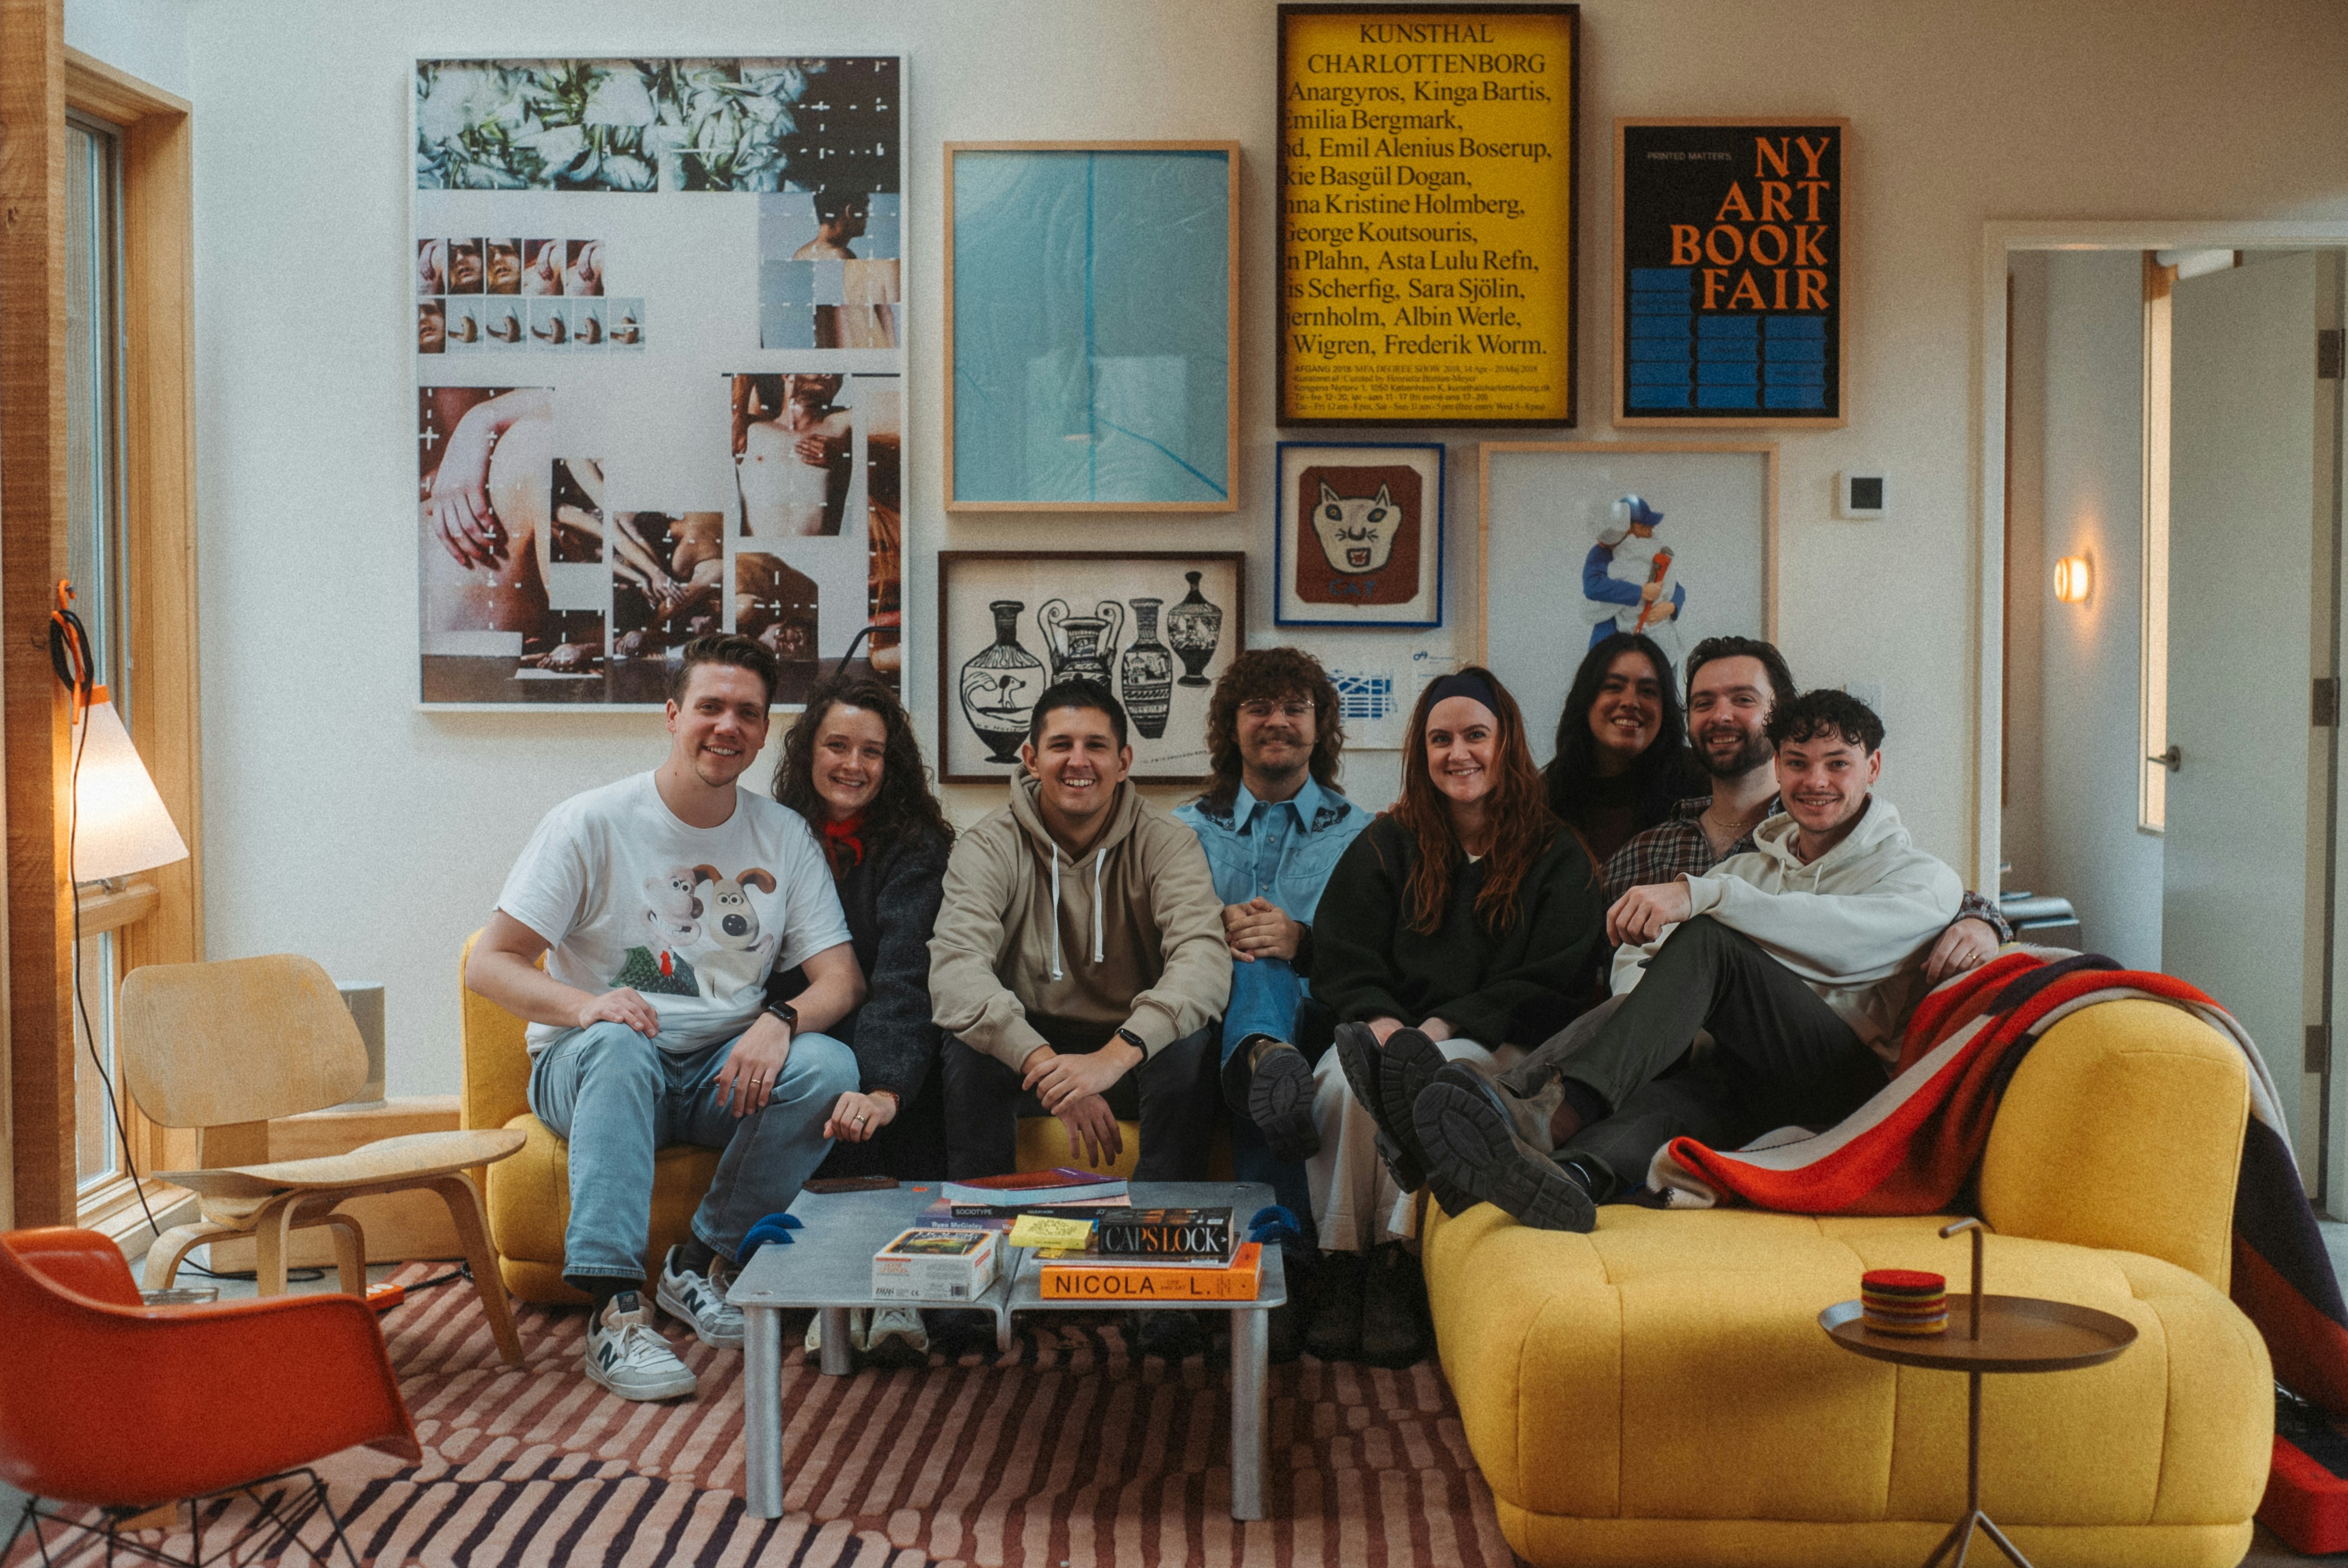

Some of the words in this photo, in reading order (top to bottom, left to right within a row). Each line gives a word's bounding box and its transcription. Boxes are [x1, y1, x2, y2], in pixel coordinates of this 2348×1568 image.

[1360, 22, 1494, 43] KUNSTHAL
[1307, 54, 1545, 73] CHARLOTTENBORG
[1288, 81, 1405, 106] Anargyros,
[1414, 81, 1477, 106] Kinga
[1483, 80, 1551, 103] Bartis,
[1352, 109, 1463, 135] Bergmark,
[1320, 137, 1368, 157] Emil
[1374, 137, 1454, 157] Alenius
[1460, 137, 1552, 163] Boserup,
[1755, 136, 1830, 178] NY
[1320, 166, 1391, 191] Basgül
[1397, 166, 1471, 191] Dogan,
[1326, 194, 1410, 214] Kristine
[1415, 193, 1525, 219] Holmberg,
[1715, 180, 1830, 221] ART
[1358, 221, 1477, 243] Koutsouris,
[1670, 224, 1828, 266] BOOK
[1288, 256, 1300, 270] n
[1305, 250, 1369, 271] Plahn,
[1378, 251, 1425, 270] Asta
[1431, 250, 1478, 270] Lulu
[1484, 250, 1539, 272] Refn,
[1289, 278, 1304, 298] is
[1309, 278, 1400, 303] Scherfig,
[1409, 278, 1454, 298] Sara
[1459, 277, 1525, 303] Sjölin,
[1702, 269, 1829, 310] FAIR
[1394, 306, 1451, 326] Albin
[1457, 306, 1521, 327] Werle,
[1293, 334, 1376, 359] Wigren,
[1386, 334, 1471, 354] Frederik
[1477, 334, 1547, 354] Worm.
[1329, 580, 1377, 596] CAT
[1055, 1276, 1155, 1294] NICOLA
[1190, 1276, 1211, 1294] L.
